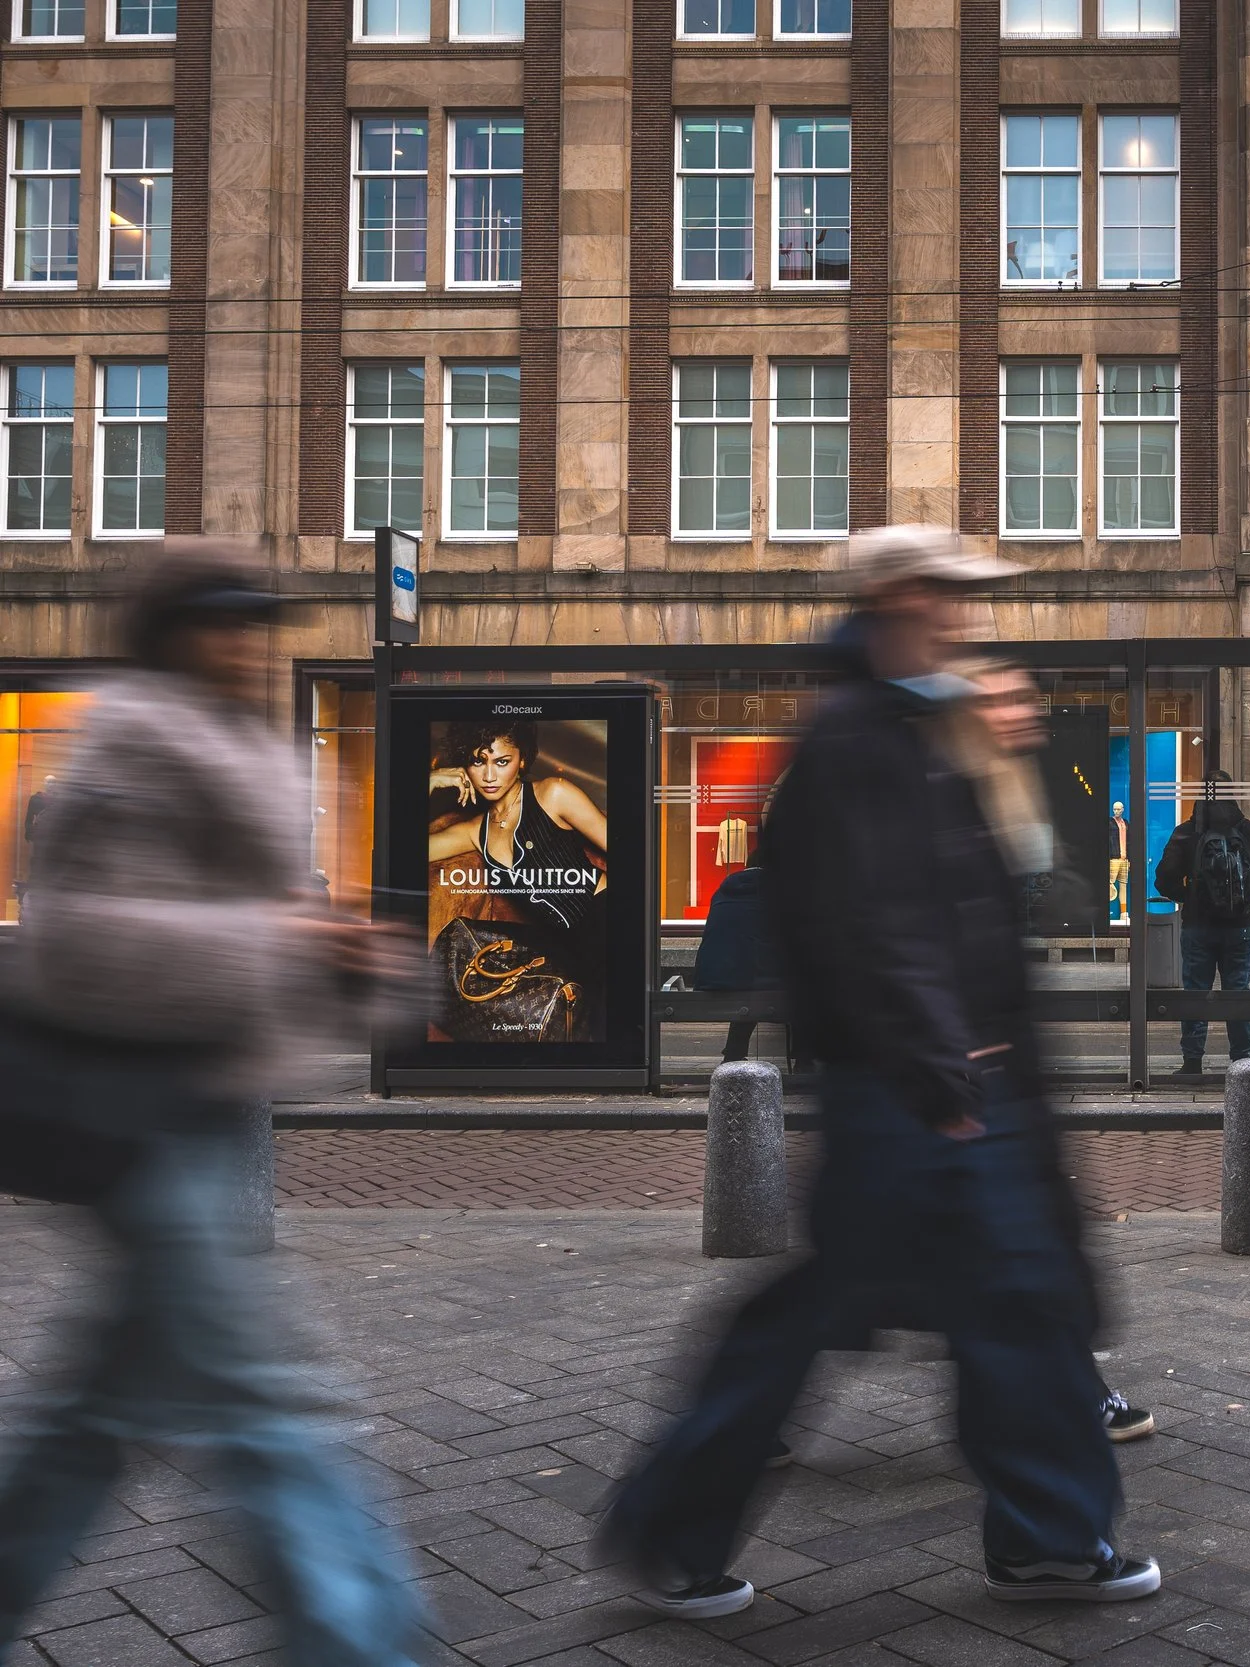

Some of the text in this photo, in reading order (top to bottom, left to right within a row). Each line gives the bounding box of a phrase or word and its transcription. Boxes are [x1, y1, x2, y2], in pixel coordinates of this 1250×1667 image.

[491, 704, 543, 714] JCDecaux
[439, 868, 597, 886] LOUIS VUITTON
[492, 1023, 501, 1031] Le
[502, 1022, 524, 1032] Speedy
[528, 1023, 543, 1031] 1930
